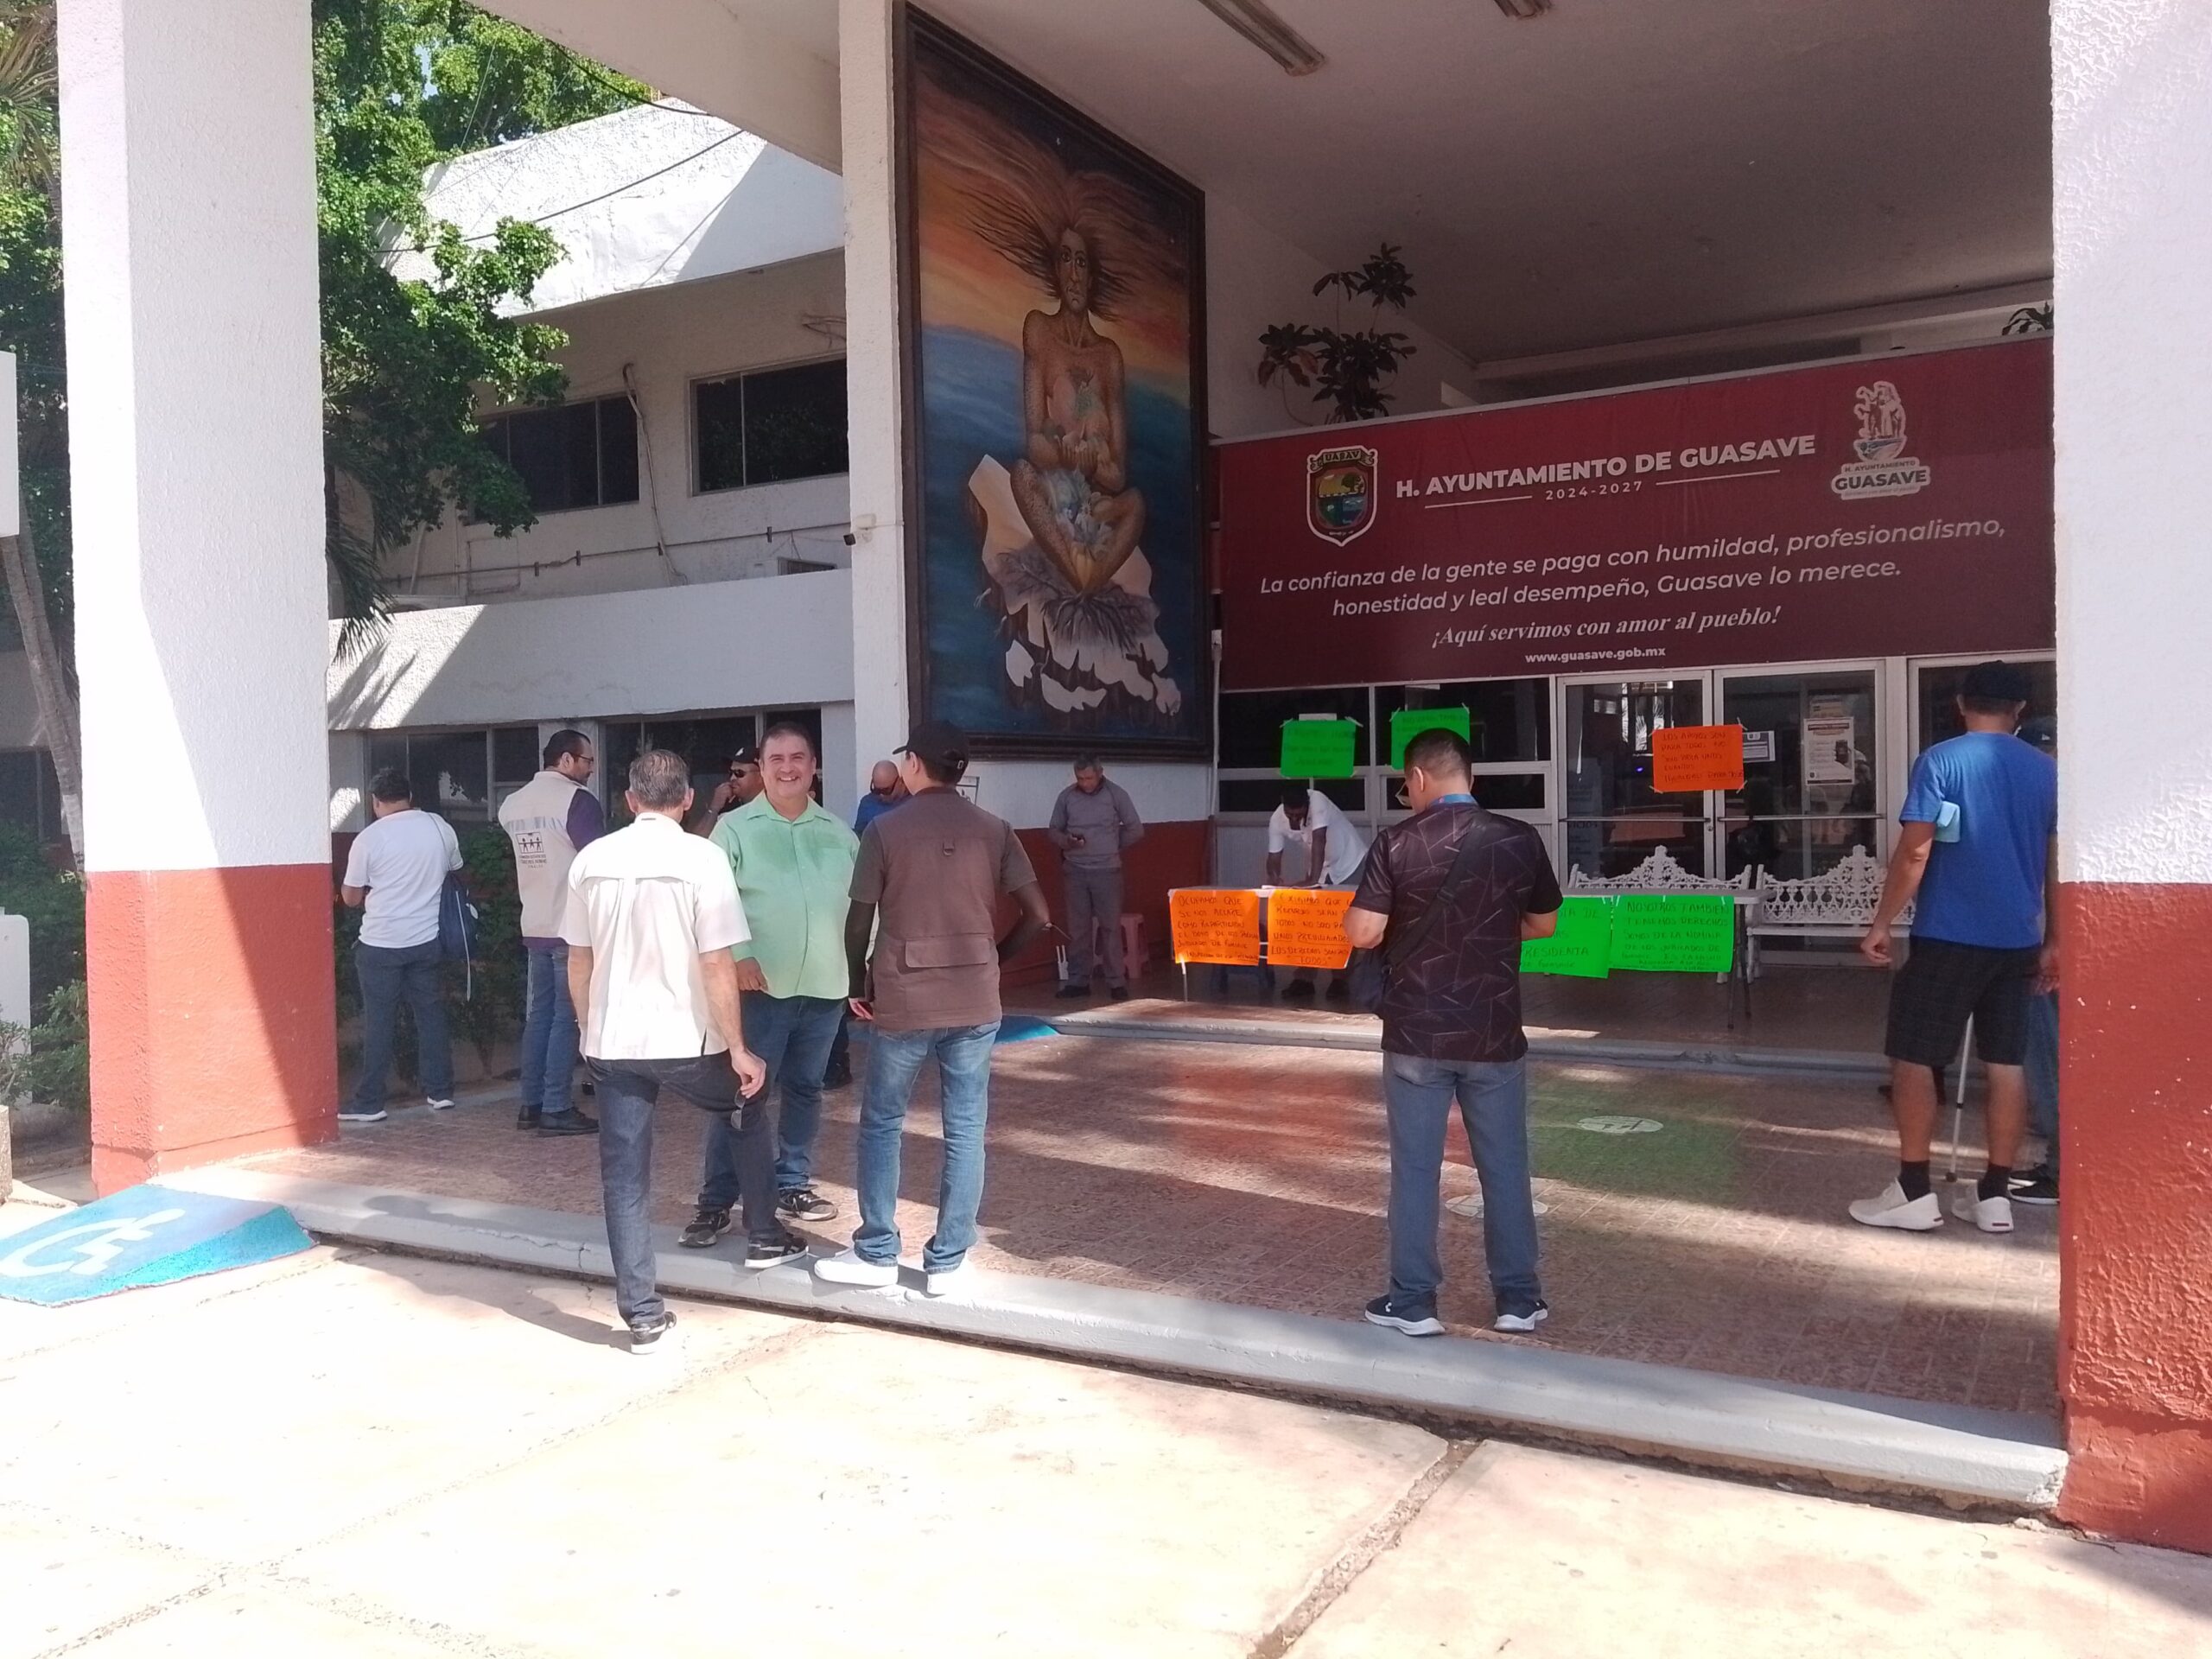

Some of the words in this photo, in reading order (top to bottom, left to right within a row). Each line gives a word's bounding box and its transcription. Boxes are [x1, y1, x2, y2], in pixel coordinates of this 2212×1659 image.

[1396, 480, 1421, 499] H.
[1426, 457, 1628, 497] AYUNTAMIENTO
[1636, 451, 1672, 474] DE
[1679, 435, 1817, 469] GUASAVE
[1835, 469, 1927, 490] GUASAVE
[1545, 480, 1643, 501] 2024-2027
[1261, 577, 1284, 594] La
[1288, 570, 1386, 592] confianza
[1391, 564, 1417, 583] de
[1421, 563, 1441, 582] la
[1446, 560, 1508, 583] gente
[1512, 560, 1537, 575] se
[1541, 554, 1601, 576] paga
[1607, 550, 1649, 567] con
[1656, 534, 1779, 563] humildad,
[1786, 519, 2005, 556] profesionalismo,
[1333, 591, 1448, 617] honestidad
[1450, 594, 1465, 613] y
[1470, 587, 1509, 607] leal
[1514, 577, 1649, 603] desempeño,
[1658, 571, 1763, 594] Guasave
[1770, 566, 1792, 584] lo
[1798, 562, 1902, 583] merece.
[1432, 625, 1488, 649] ¡Aquí
[1489, 622, 1573, 641] servimos
[1577, 621, 1612, 636] con
[1616, 617, 1672, 634] amor
[1675, 612, 1697, 630] al
[1697, 606, 1782, 634] pueblo!
[1525, 647, 1666, 664] www.guasave.gob.mx
[1224, 896, 1243, 906] QUE
[1627, 901, 1676, 912] NOSOTROS
